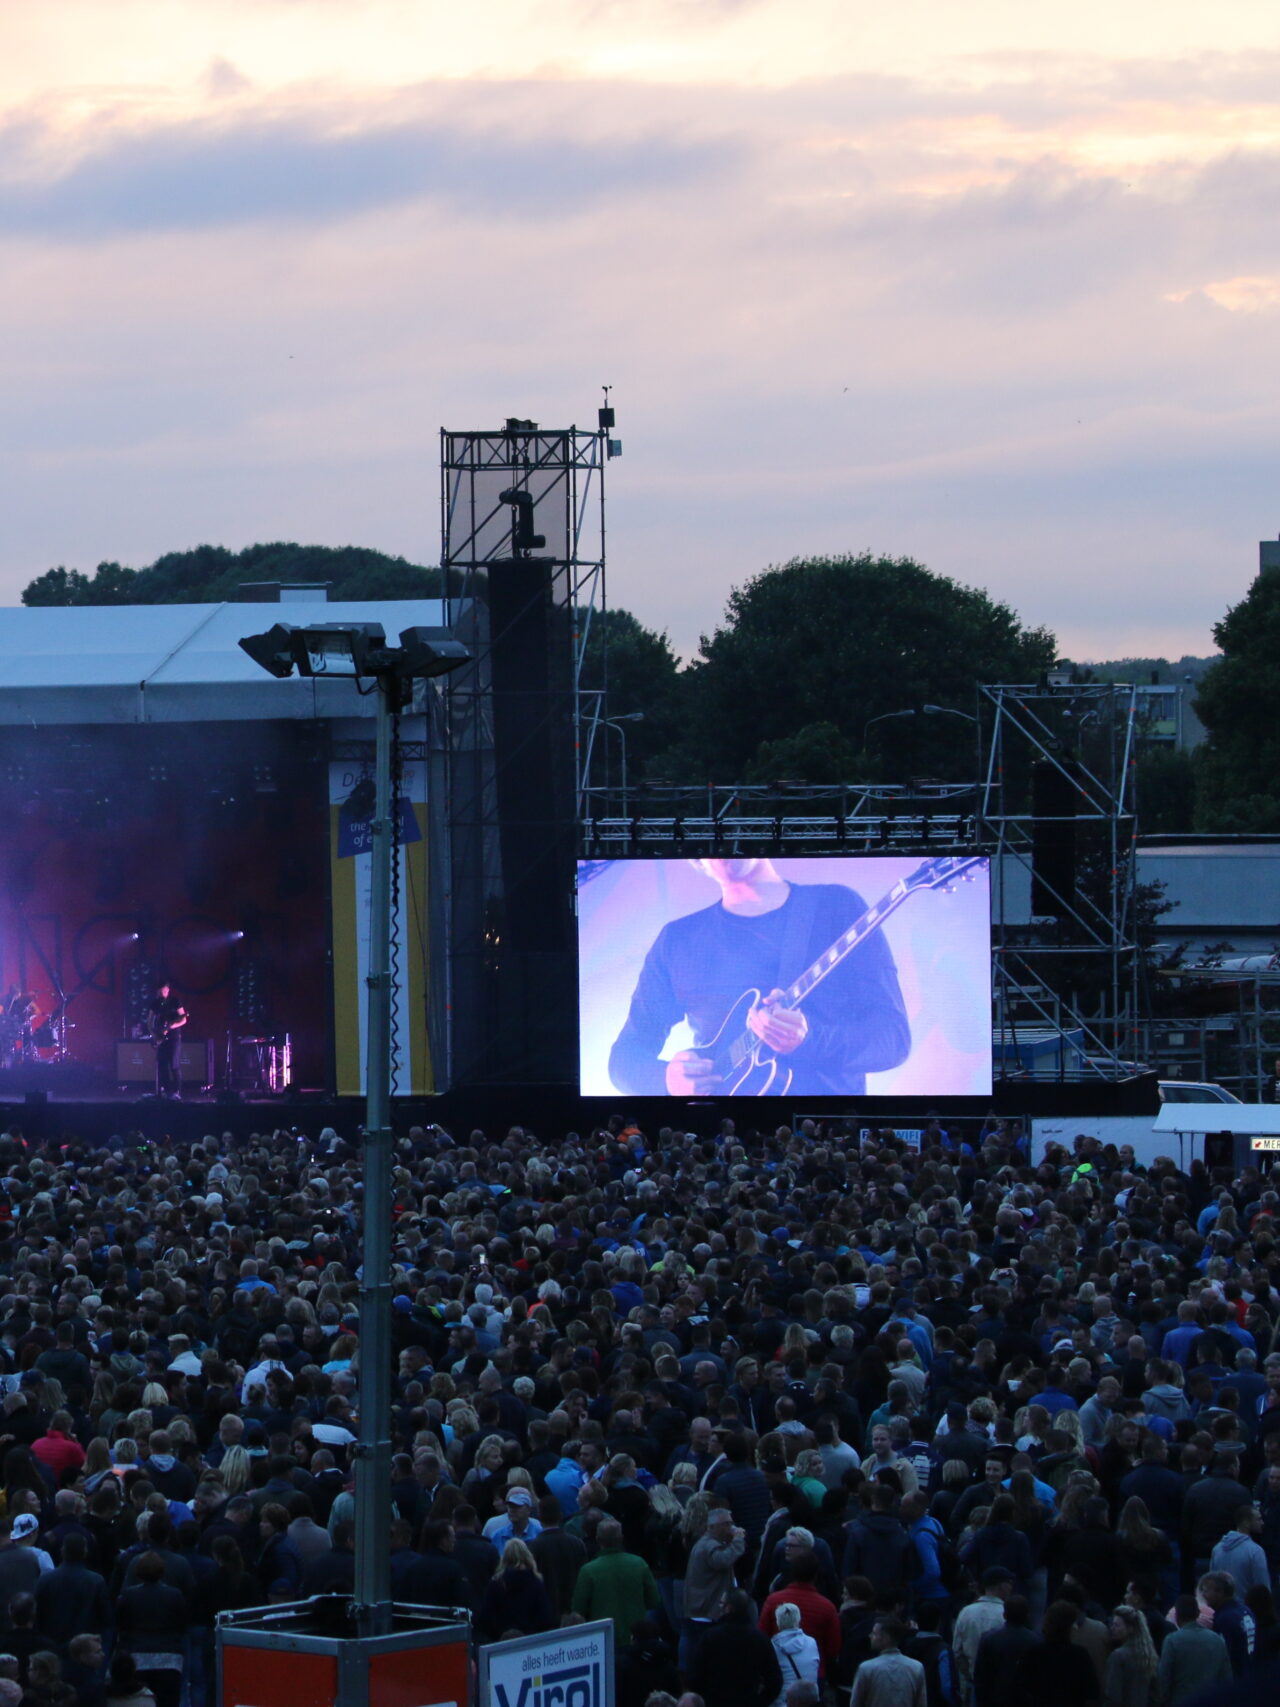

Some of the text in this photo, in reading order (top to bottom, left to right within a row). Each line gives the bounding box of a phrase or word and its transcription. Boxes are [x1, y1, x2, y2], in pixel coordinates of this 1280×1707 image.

[353, 833, 365, 848] of
[522, 1642, 599, 1671] alles heeft waarde.
